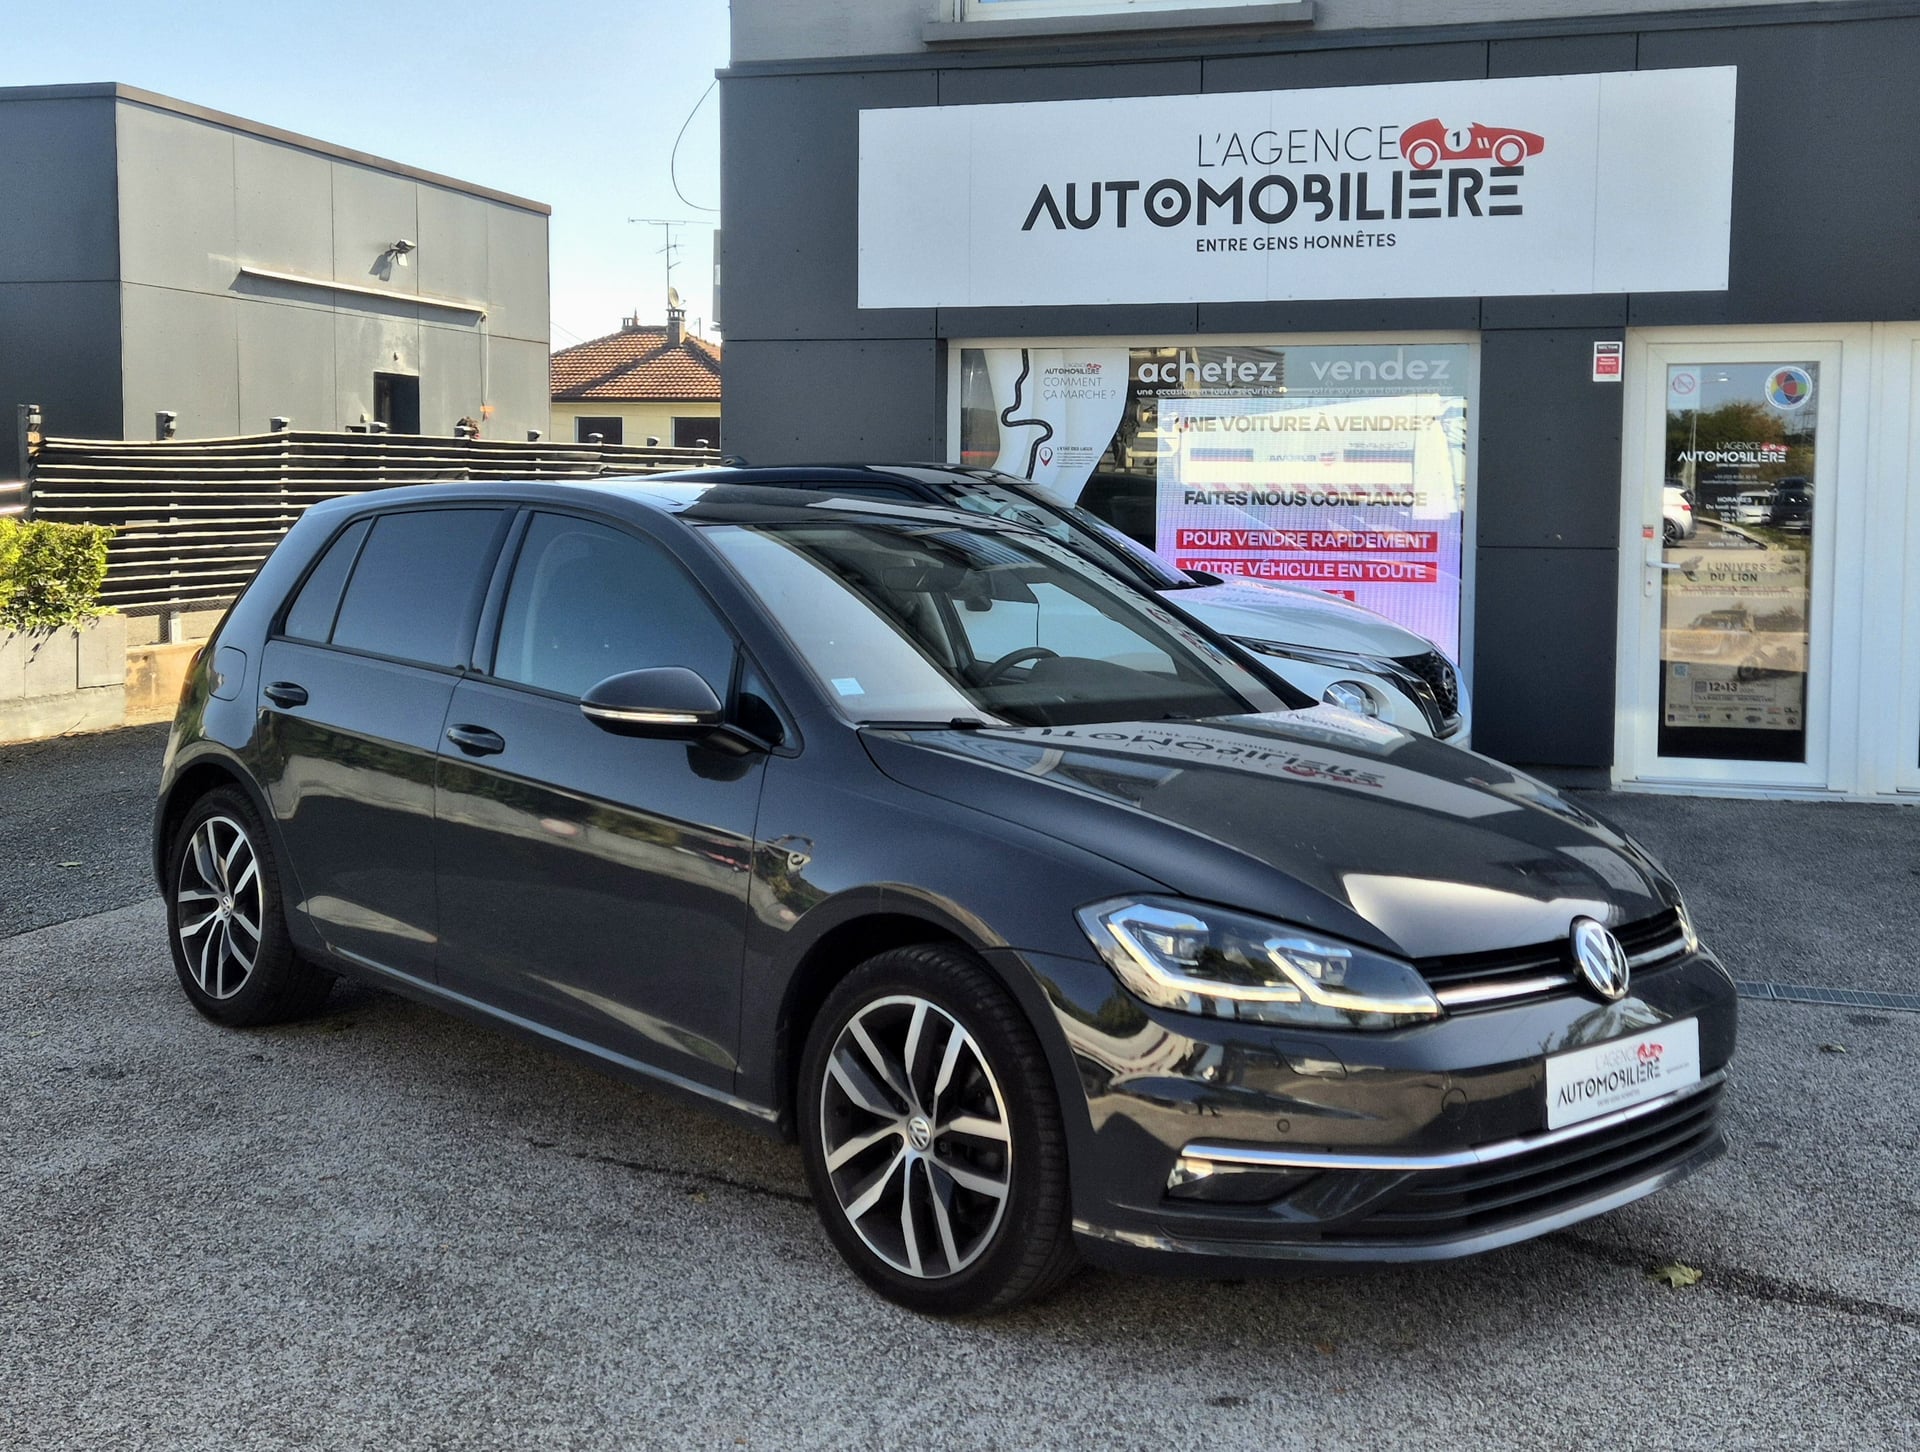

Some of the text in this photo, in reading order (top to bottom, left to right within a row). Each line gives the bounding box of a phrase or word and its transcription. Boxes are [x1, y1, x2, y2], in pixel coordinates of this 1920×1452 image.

[1197, 125, 1399, 168] L'AGENCE
[1451, 130, 1462, 147] 1
[1195, 230, 1397, 252] ENTRE GENS HONNÊTES
[1137, 350, 1278, 384] achetez
[1310, 349, 1451, 381] vendez
[1043, 377, 1104, 387] COMMENT
[1043, 390, 1058, 402] ÇA
[1060, 390, 1107, 400] MARCHE
[1136, 388, 1153, 396] une
[1220, 415, 1311, 433] VOITURE
[1312, 412, 1332, 432] À
[1716, 441, 1761, 450] L'AGENCE
[1184, 490, 1428, 507] FAITES NOUS CONFIANCE
[1182, 531, 1431, 549] POUR VENDRE RAPIDEMENT
[1185, 558, 1427, 579] VOTRE VÉHICULE EN TOUTE
[1710, 573, 1758, 582] DU LION
